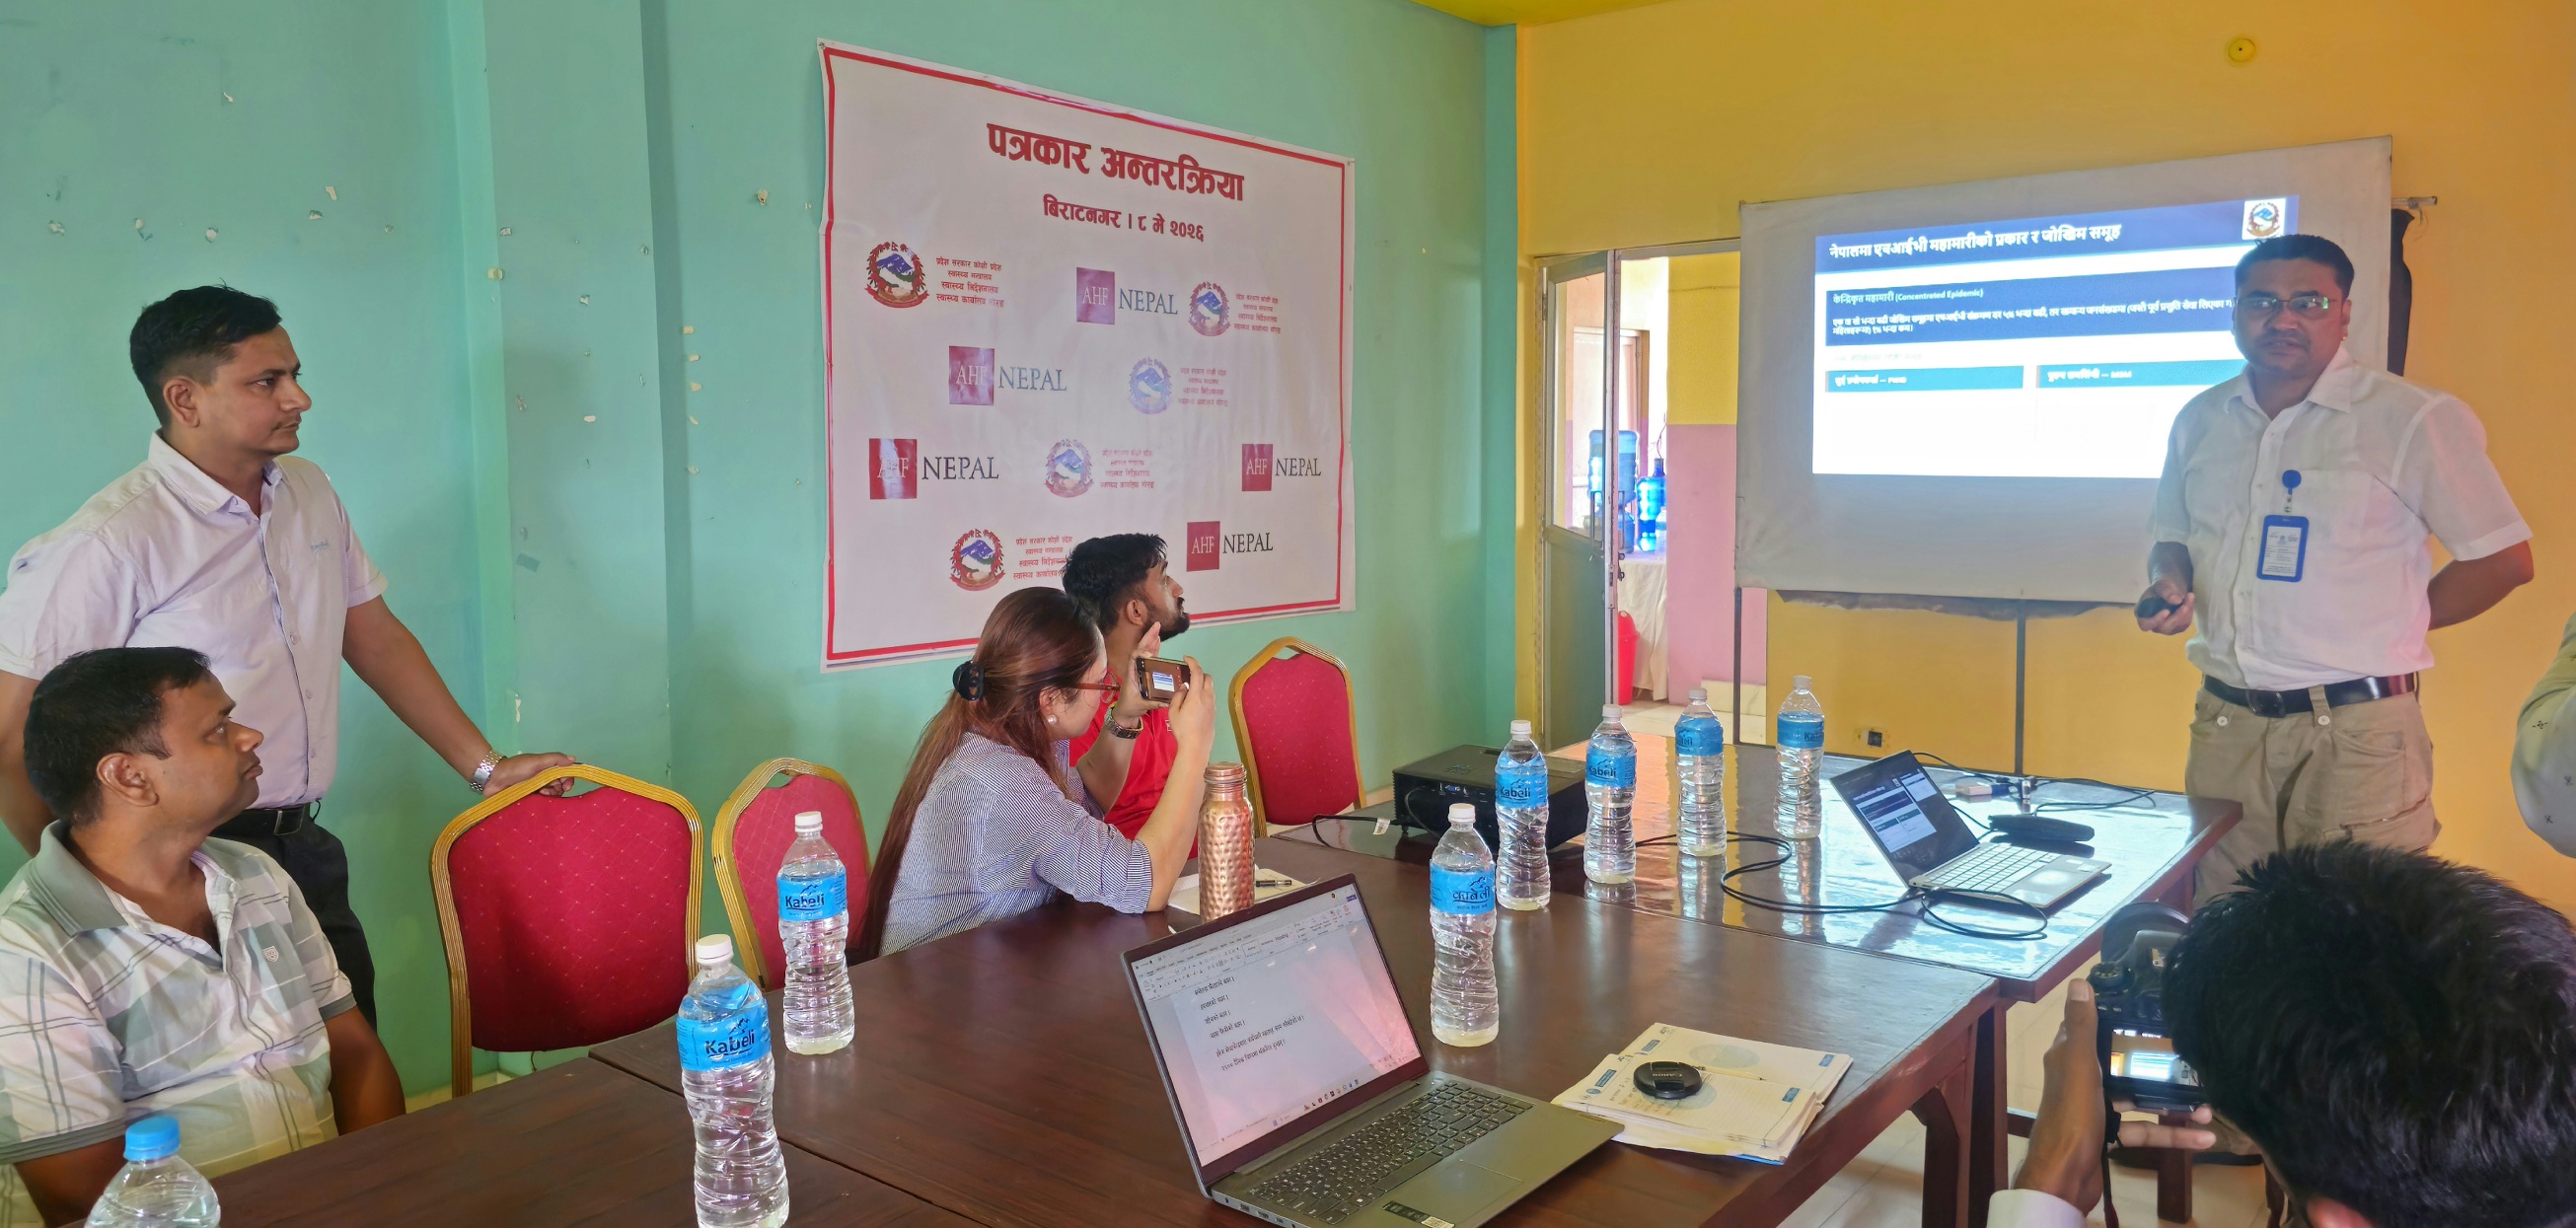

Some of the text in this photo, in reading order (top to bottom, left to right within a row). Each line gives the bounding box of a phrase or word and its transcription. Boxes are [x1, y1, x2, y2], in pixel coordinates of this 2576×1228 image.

[987, 123, 1244, 201] पत्रकार अन्तरक्रिया
[1043, 193, 1121, 228] बिराटनगर
[1138, 215, 1146, 231] ८
[1152, 213, 1164, 234] मे
[1170, 220, 1205, 242] २०२६
[1829, 224, 2122, 257] नेपालमा एचआईभी महामारीको प्रकार र जोखिम समूह
[952, 259, 971, 268] सरकार
[1081, 286, 1178, 315] AHF NEPAL
[1865, 291, 1893, 303] महामारी
[998, 366, 1067, 392] NEPAL
[921, 456, 999, 480] NEPAL
[1246, 458, 1322, 476] AHF NEPAL
[1191, 532, 1274, 554] AHF NEPAL
[1588, 767, 1616, 777] Kabeli
[1501, 787, 1530, 798] Kabeli
[784, 894, 825, 908] Kabeli
[705, 1029, 755, 1054] Kabeli
